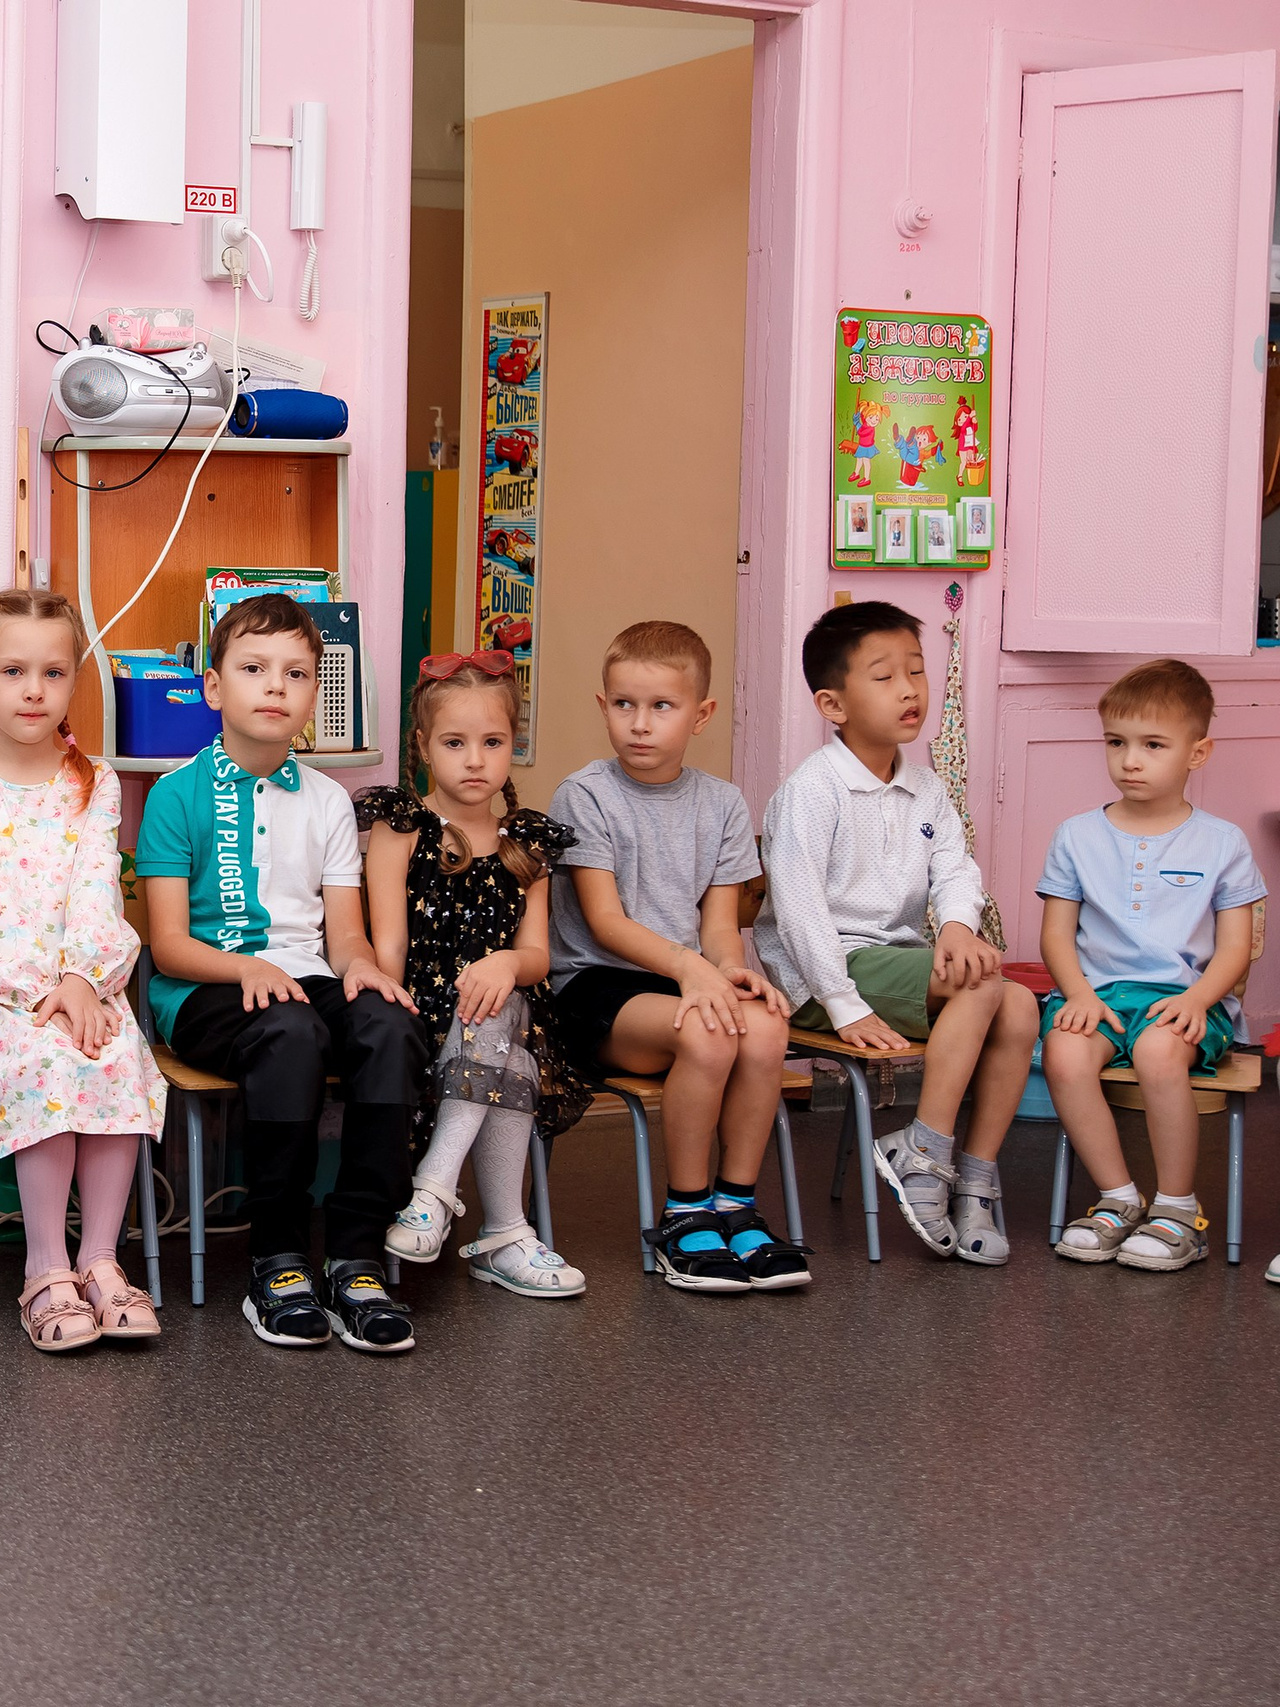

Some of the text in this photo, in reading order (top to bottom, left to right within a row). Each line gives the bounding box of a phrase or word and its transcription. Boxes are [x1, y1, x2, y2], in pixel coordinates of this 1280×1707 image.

[190, 191, 217, 207] 220
[496, 310, 509, 328] ТАК
[847, 353, 986, 385] ДЕЖУРСТВ
[496, 392, 538, 425] БЫСТРЕЕ!
[882, 391, 947, 406] по группе
[215, 577, 239, 588] 50
[491, 575, 532, 614] ВЫШЕ!
[213, 780, 239, 826] STAY
[216, 829, 246, 913] PLUGGED
